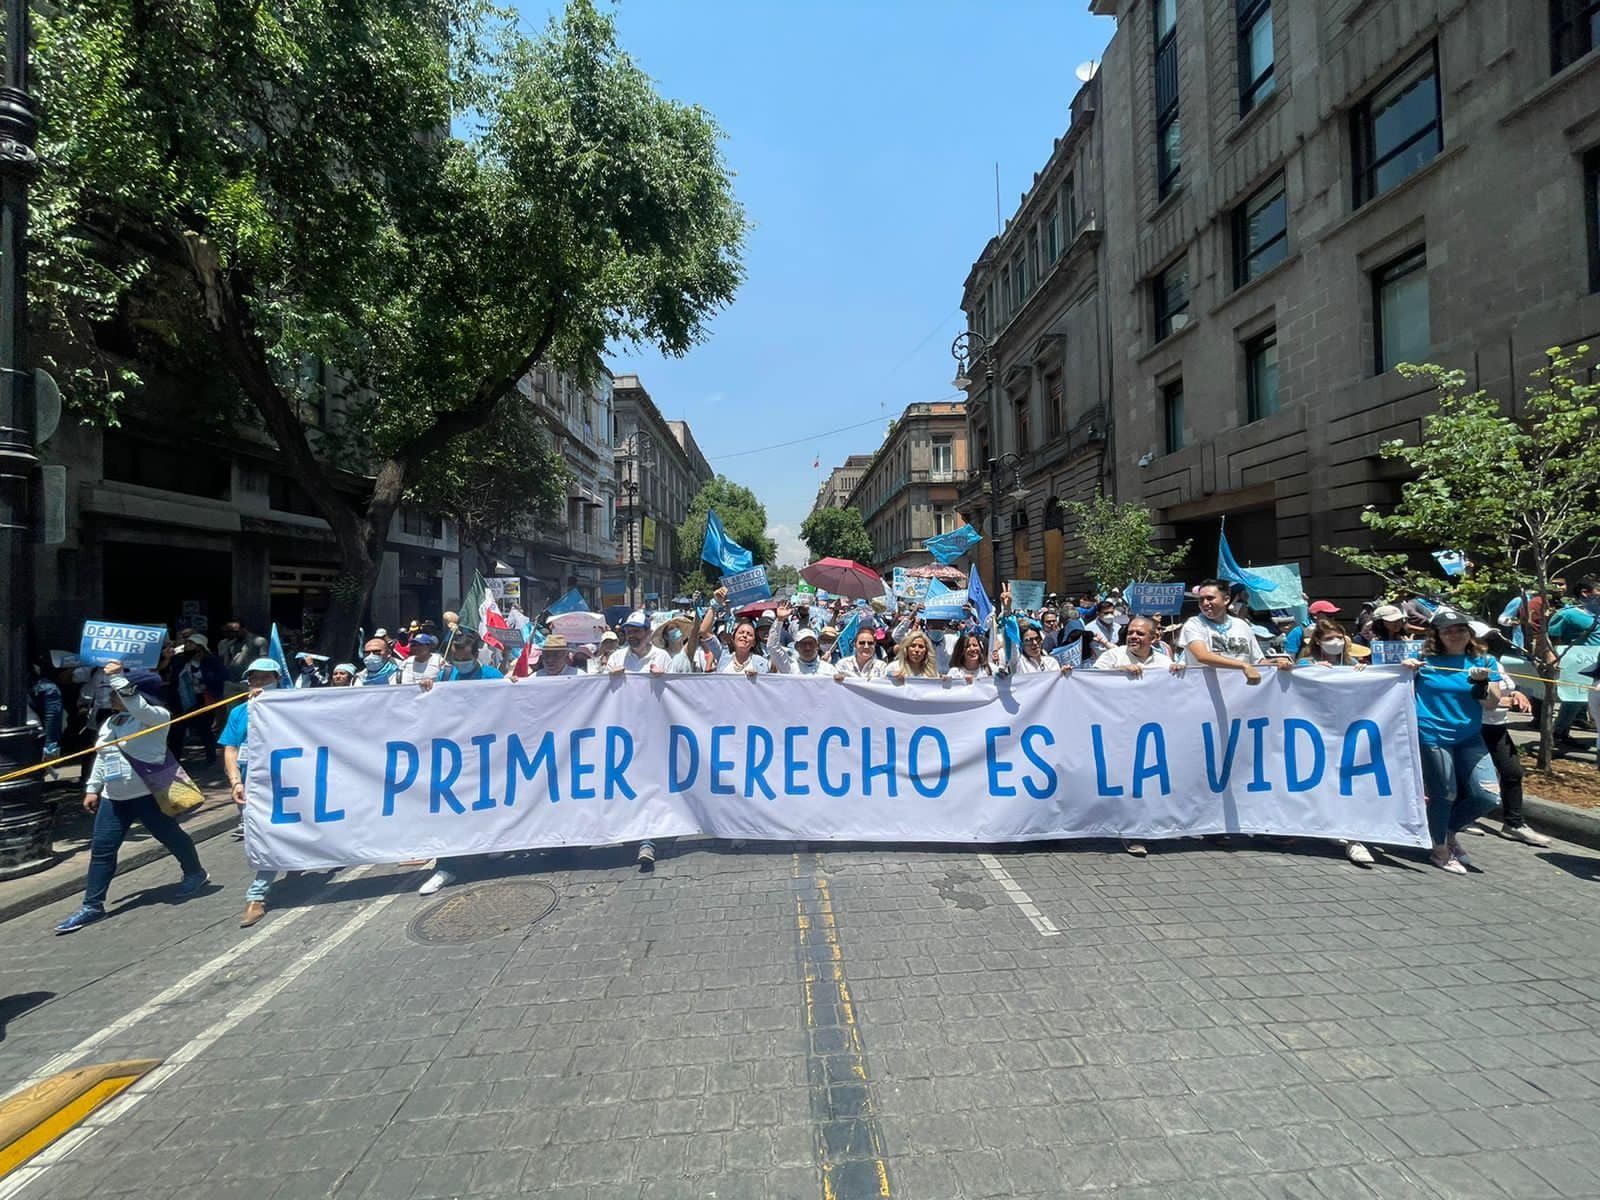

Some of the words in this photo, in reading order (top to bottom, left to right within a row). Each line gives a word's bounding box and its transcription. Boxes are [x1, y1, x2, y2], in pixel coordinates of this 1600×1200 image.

[95, 640, 142, 653] LATIR
[270, 746, 345, 825] EL
[382, 725, 638, 817] PRIMER
[668, 725, 951, 801] DERECHO
[985, 724, 1058, 800] ES
[1091, 722, 1171, 799] LA
[1202, 717, 1392, 797] VIDA
